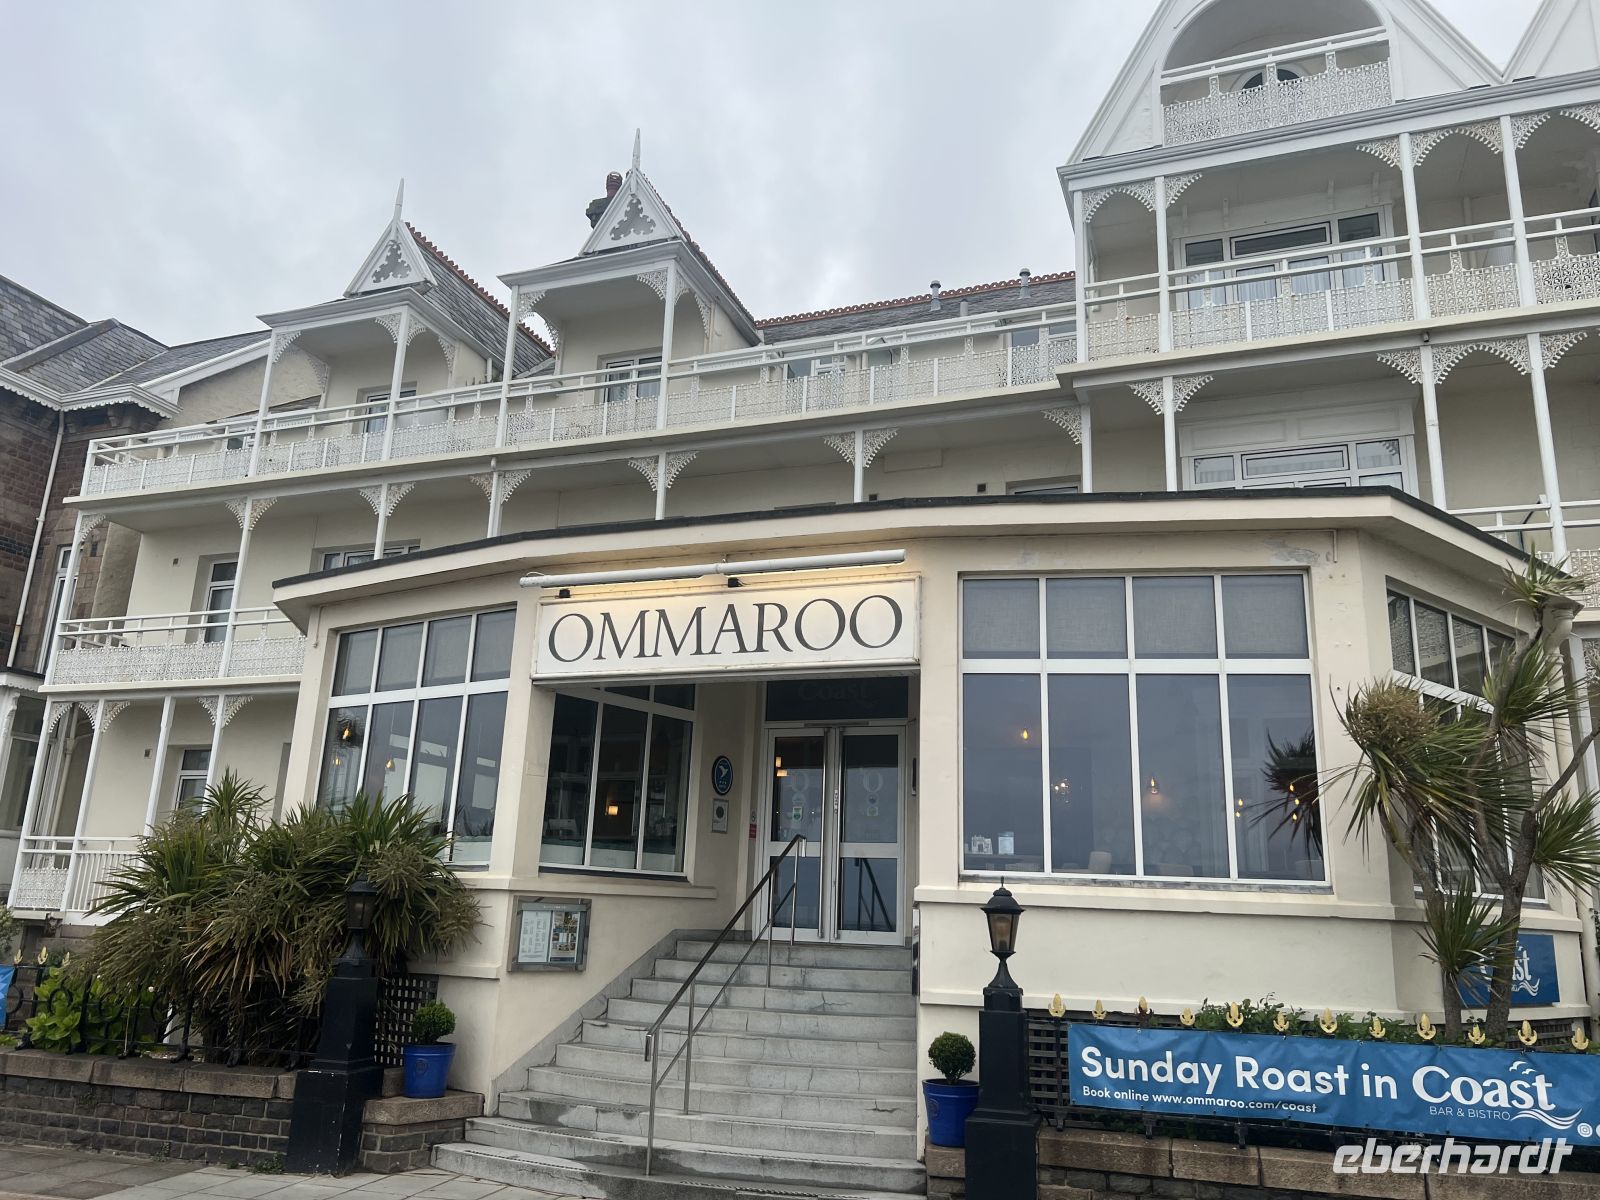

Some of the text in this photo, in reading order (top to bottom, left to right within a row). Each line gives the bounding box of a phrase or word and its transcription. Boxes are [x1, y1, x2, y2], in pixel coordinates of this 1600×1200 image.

[547, 594, 903, 663] OMMAROO
[1081, 1046, 1556, 1111] Sunday Roast in Coast
[1082, 1085, 1317, 1113] Book online www.ommaroo.com/coast
[1429, 1106, 1511, 1121] BAR & BISTRO
